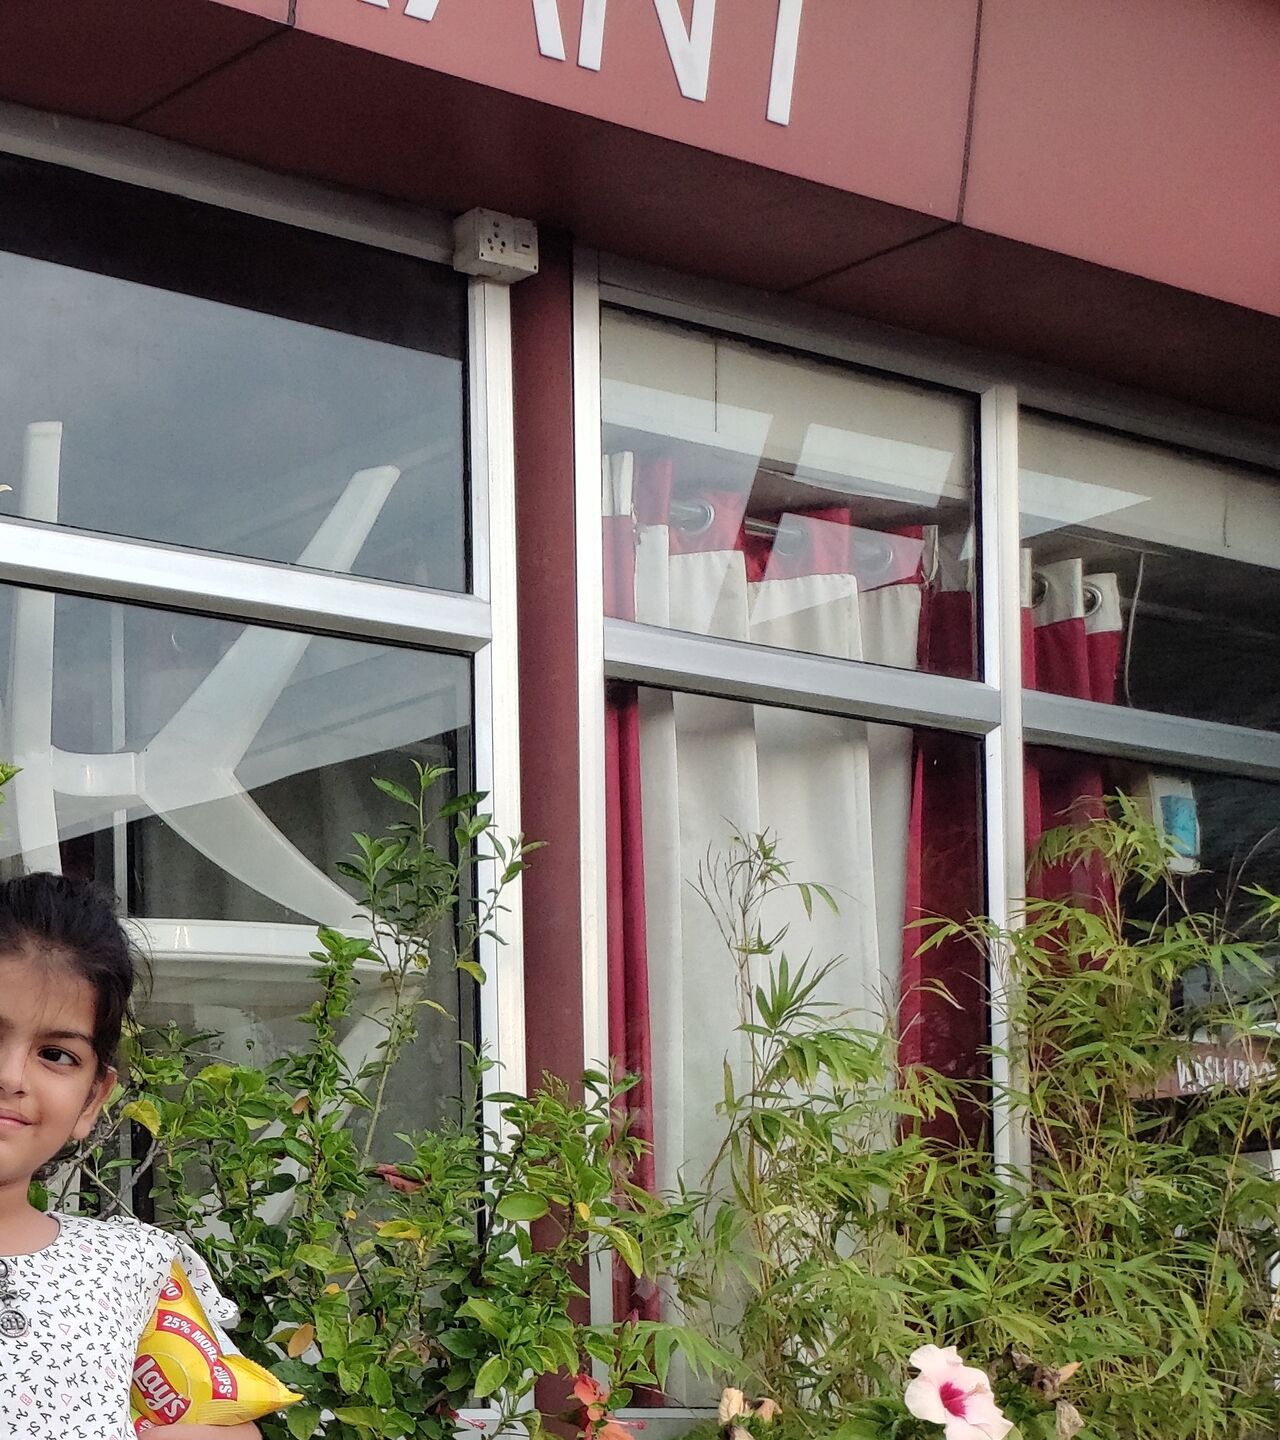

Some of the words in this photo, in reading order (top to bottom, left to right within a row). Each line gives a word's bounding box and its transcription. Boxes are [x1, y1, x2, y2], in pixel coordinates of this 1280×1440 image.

[163, 1315, 191, 1334] 25%
[191, 1331, 218, 1362] MORE
[133, 1358, 185, 1418] Lay's
